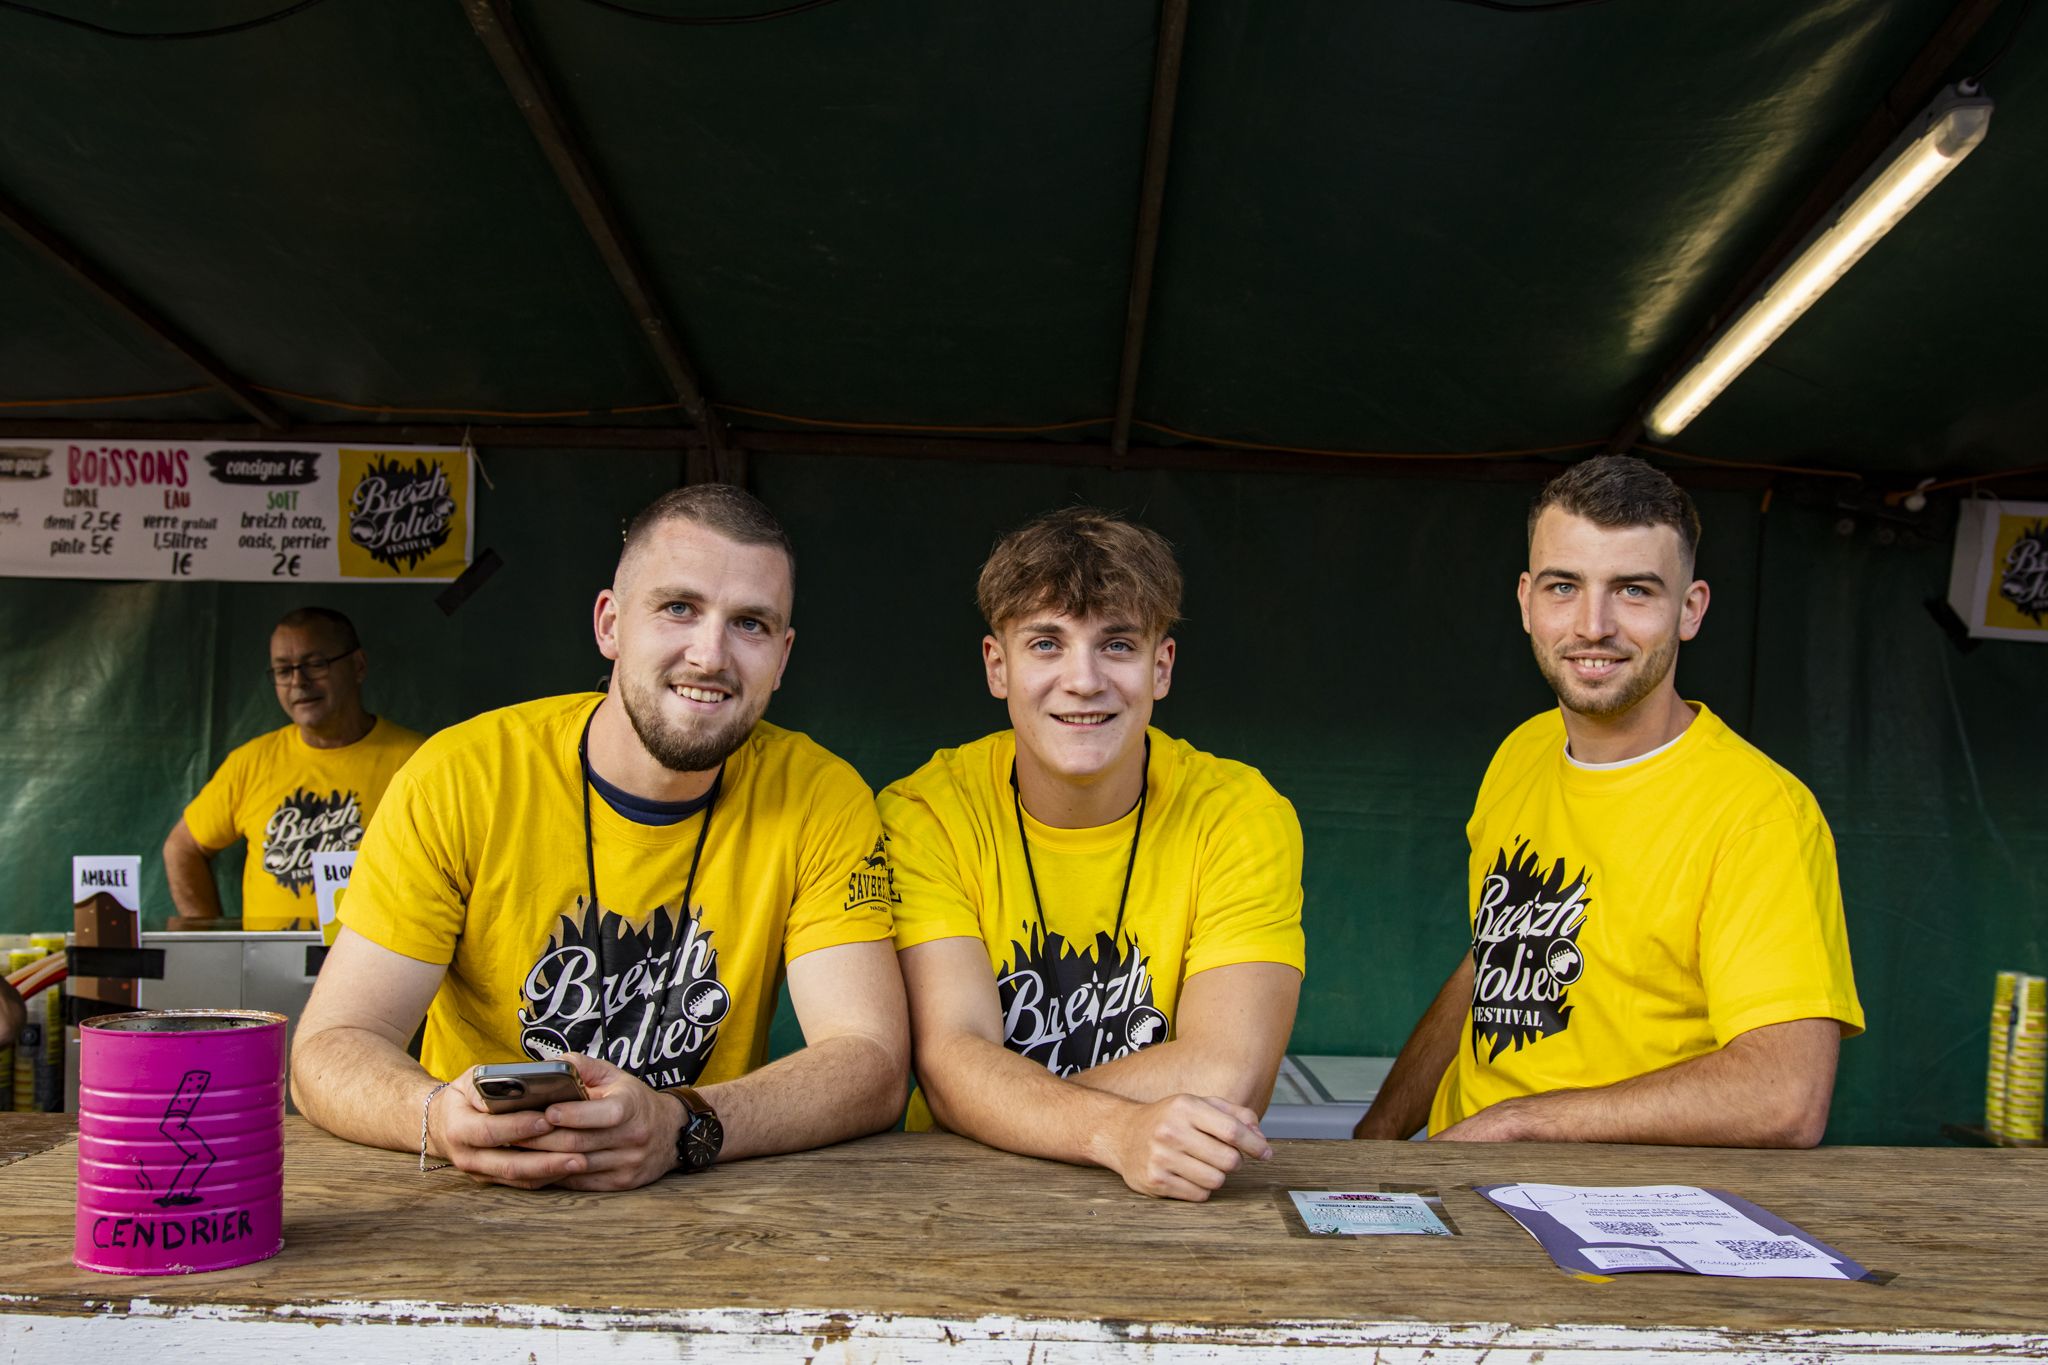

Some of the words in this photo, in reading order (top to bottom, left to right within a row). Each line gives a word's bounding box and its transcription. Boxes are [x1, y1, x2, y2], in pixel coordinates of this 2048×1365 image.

[225, 458, 284, 481] consigne
[288, 459, 305, 476] 1€
[63, 488, 99, 508] CIDRE
[163, 490, 191, 510] EAU
[266, 490, 300, 510] SOFT
[348, 466, 448, 520] Breizh
[43, 513, 77, 531] demi
[81, 511, 121, 533] 2,5€
[143, 515, 178, 530] verre
[182, 517, 218, 533] gratuit
[240, 512, 287, 529] breizh
[291, 515, 326, 531] coca,
[369, 505, 443, 549] Folies
[50, 537, 86, 557] pinte
[90, 534, 114, 555] 5€
[238, 533, 276, 550] oasis,
[280, 534, 331, 553] perrier
[385, 537, 434, 556] FESTIVAL
[172, 551, 193, 575] 1€
[272, 553, 301, 577] 2€
[262, 797, 362, 850] Breizh
[1472, 874, 1588, 945] Breizh
[518, 919, 719, 1027] Breizh
[1472, 942, 1560, 1005] Folies
[997, 944, 1153, 1046] Breizh
[1473, 1006, 1543, 1027] FESTIVAL
